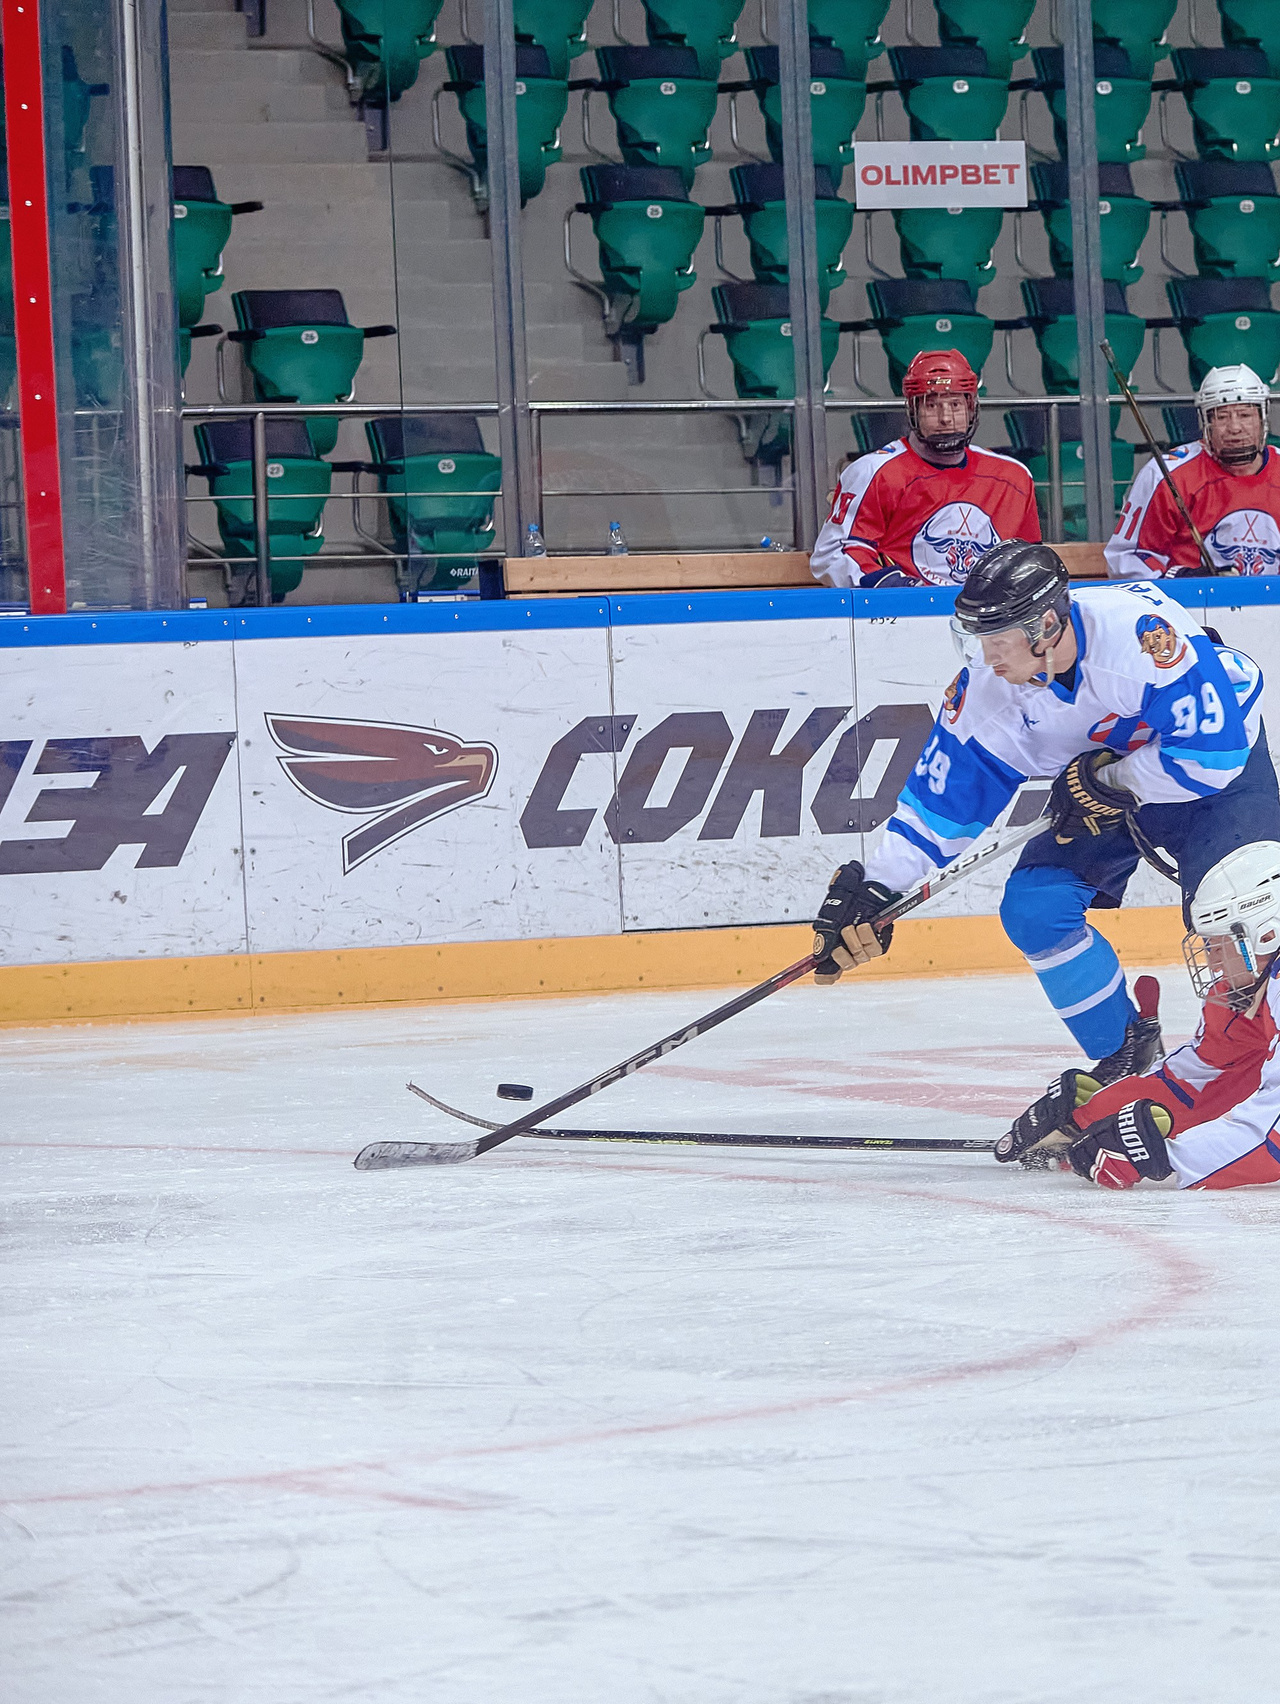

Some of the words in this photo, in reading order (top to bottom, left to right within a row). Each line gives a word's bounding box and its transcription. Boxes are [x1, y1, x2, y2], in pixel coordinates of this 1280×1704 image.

[861, 164, 1021, 186] OLIMPBET
[1170, 682, 1225, 738] 99
[519, 703, 1056, 849] СОКО
